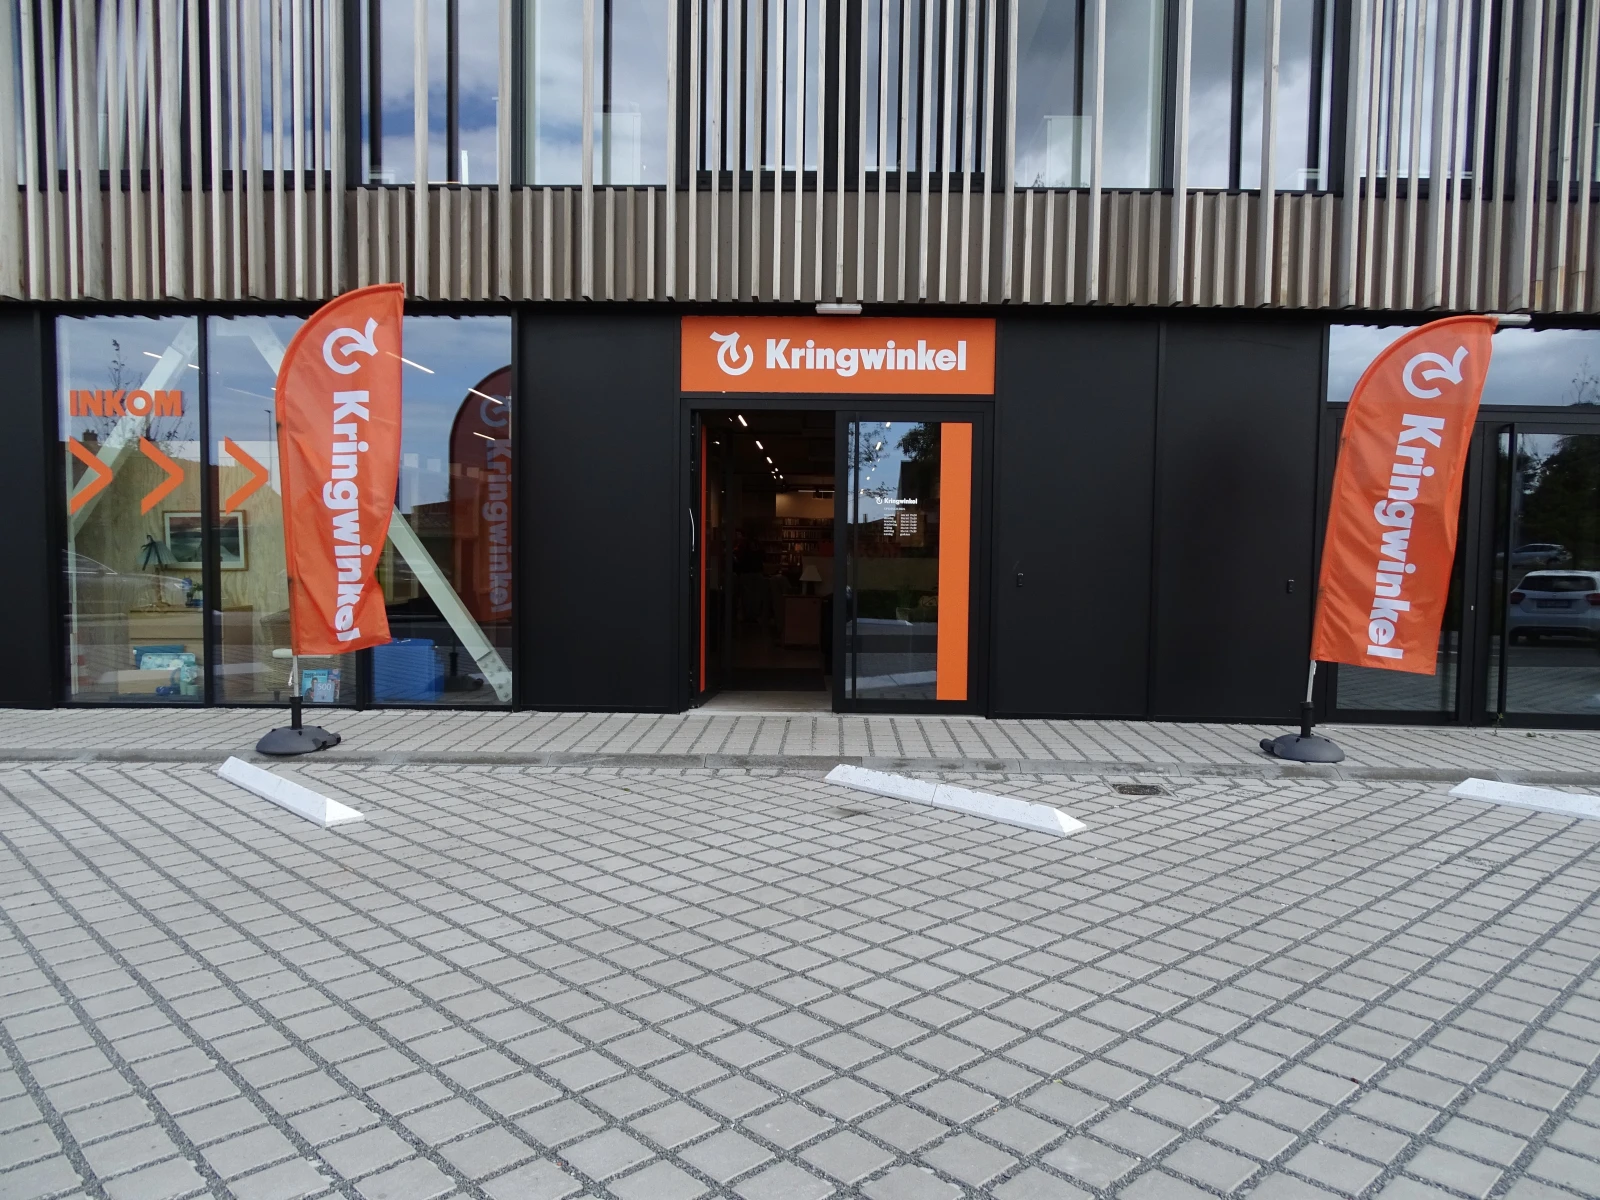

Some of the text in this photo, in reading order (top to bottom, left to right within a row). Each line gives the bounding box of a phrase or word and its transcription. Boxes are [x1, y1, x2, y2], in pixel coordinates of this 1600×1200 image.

[69, 390, 182, 417] INKOM
[766, 339, 967, 378] Kringwinkel
[322, 390, 372, 642] Kringwinkel
[1366, 413, 1445, 660] Kringwinkel
